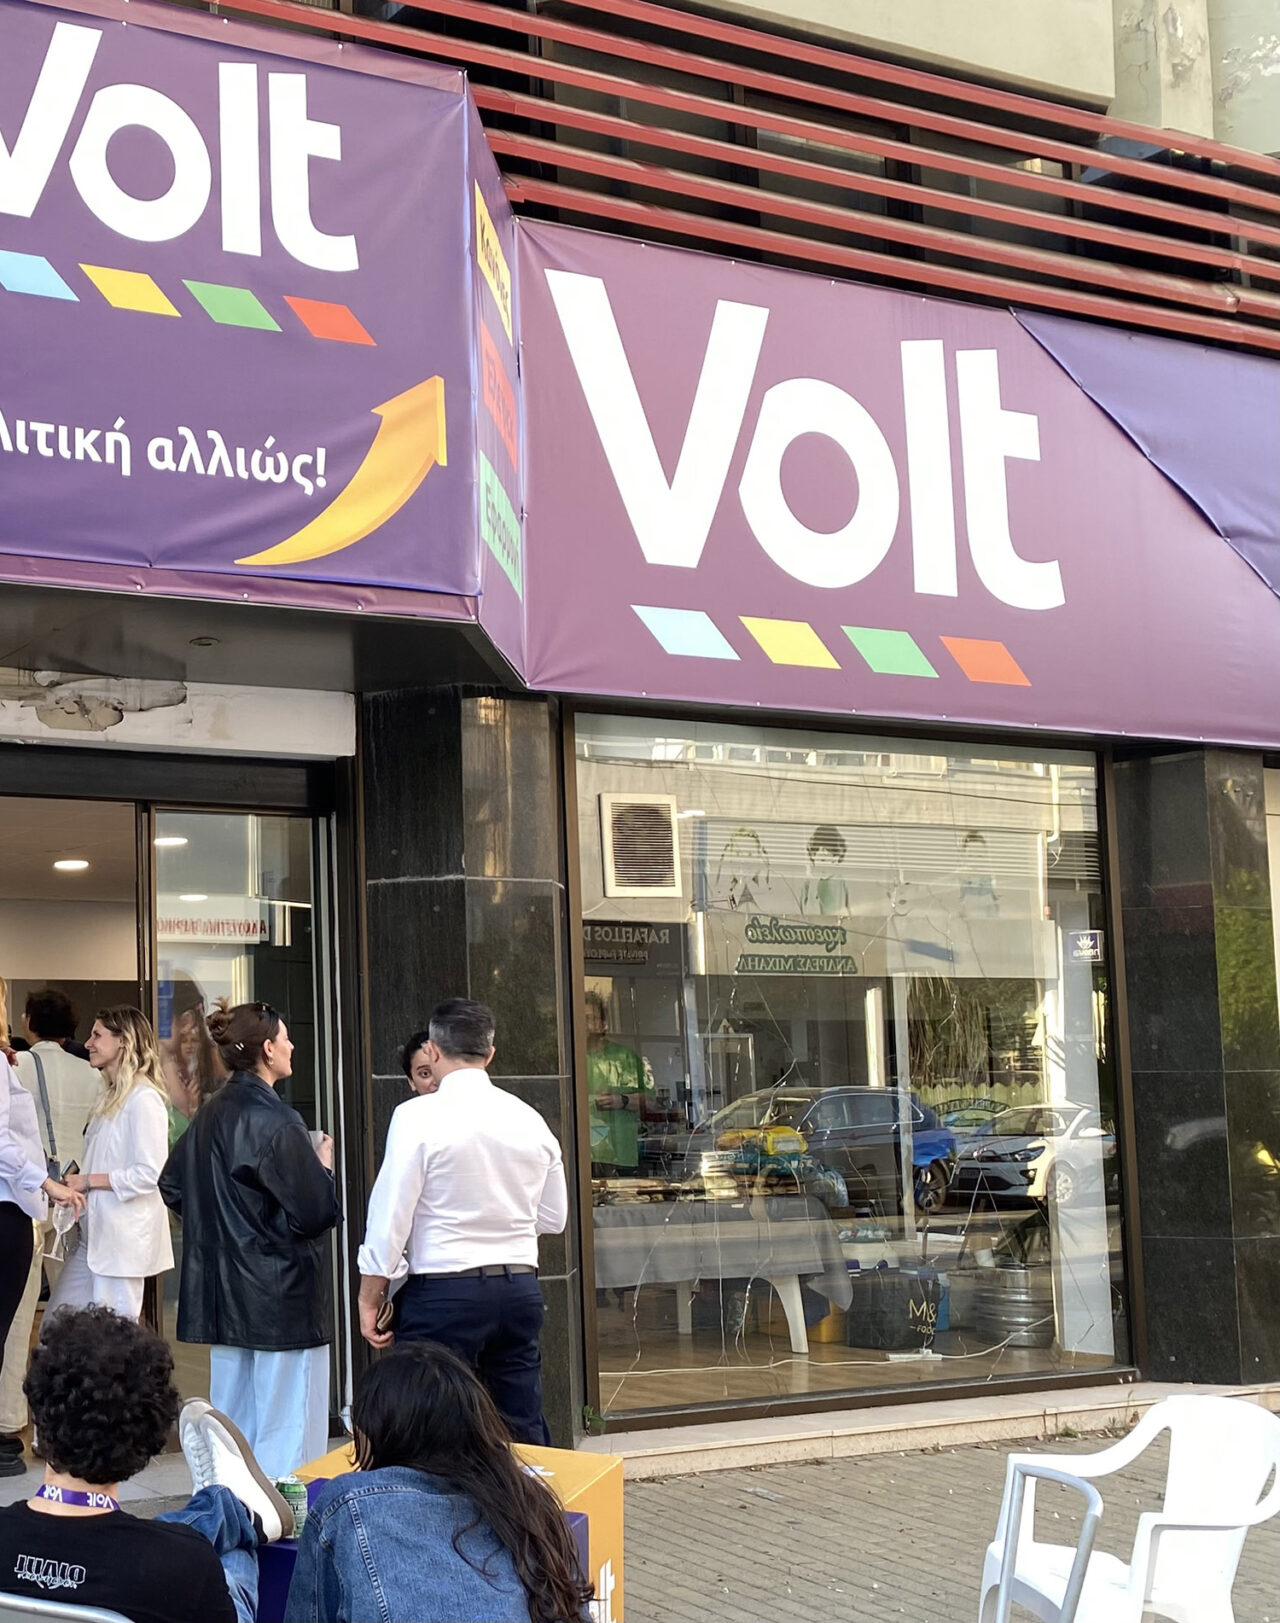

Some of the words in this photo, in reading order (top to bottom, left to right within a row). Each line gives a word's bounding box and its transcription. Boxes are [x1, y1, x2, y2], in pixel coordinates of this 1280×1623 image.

[146, 426, 328, 497] αλλιώς!
[544, 268, 1066, 611] Volt
[87, 1492, 115, 1510] Volt
